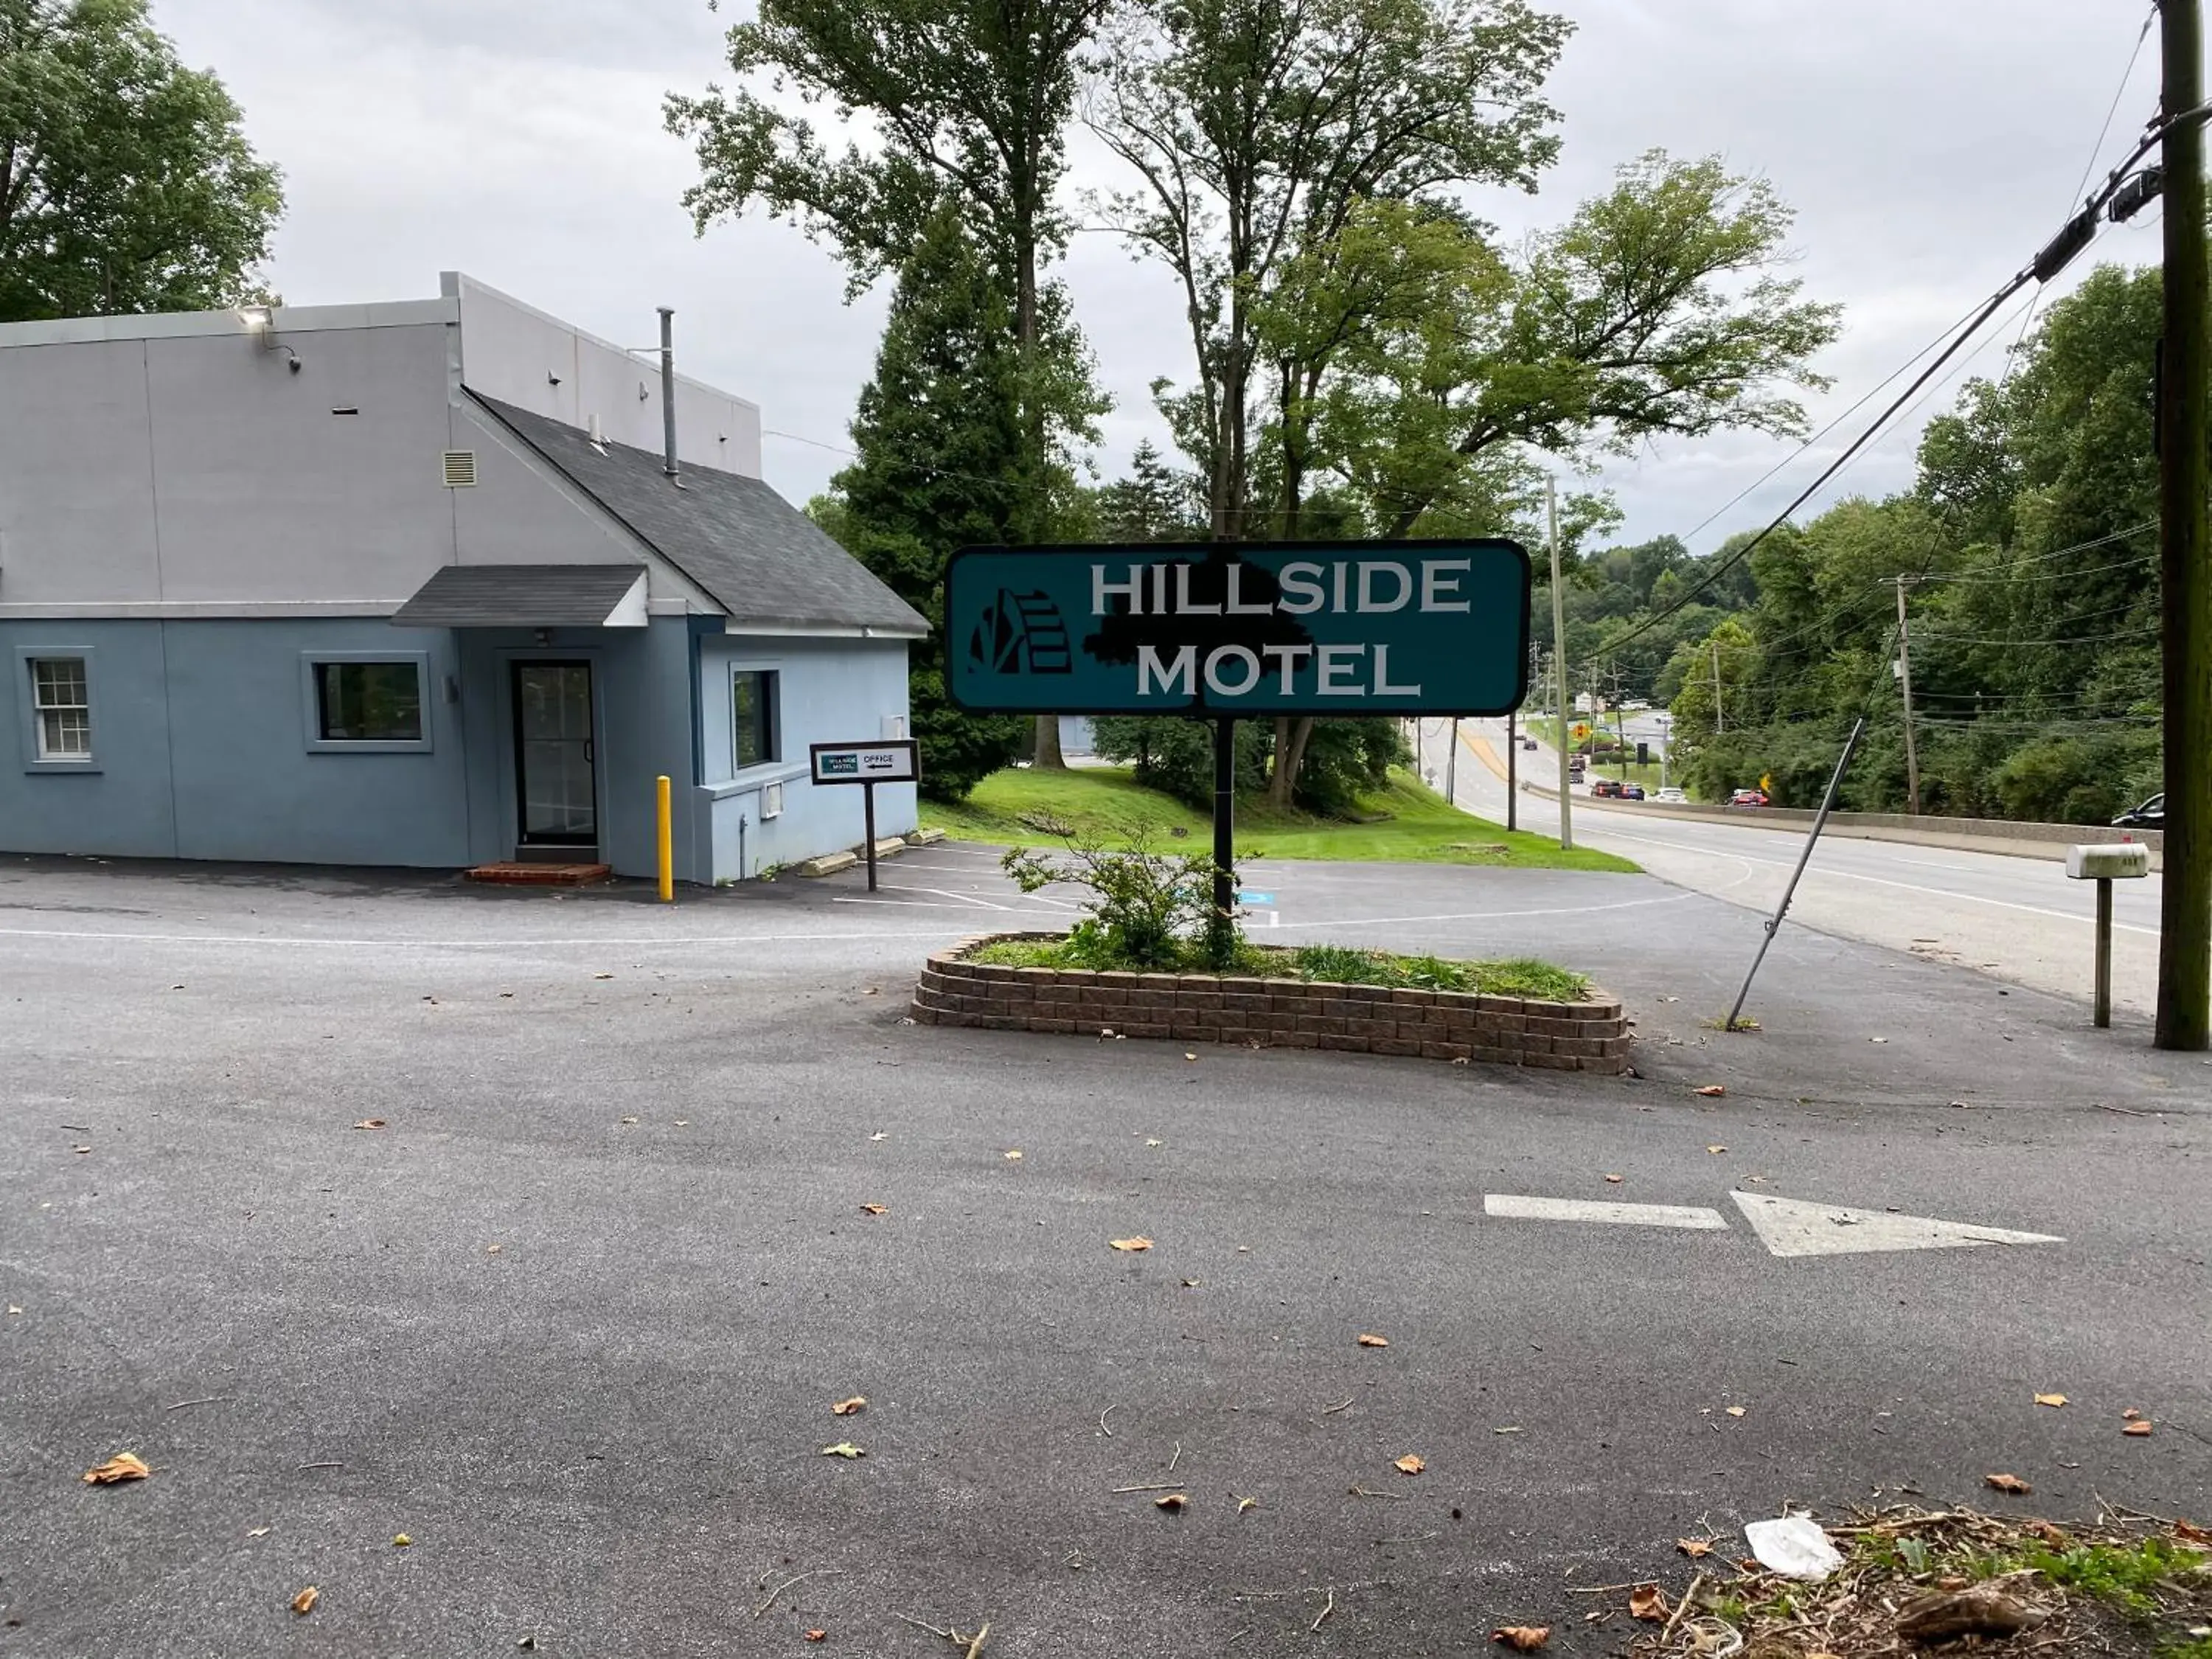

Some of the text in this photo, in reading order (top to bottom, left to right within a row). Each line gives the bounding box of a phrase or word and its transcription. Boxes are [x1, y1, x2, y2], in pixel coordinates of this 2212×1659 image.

[1091, 559, 1471, 615] HILLSIDE
[1136, 644, 1421, 697] MOTEL
[863, 755, 894, 763] OFFICE
